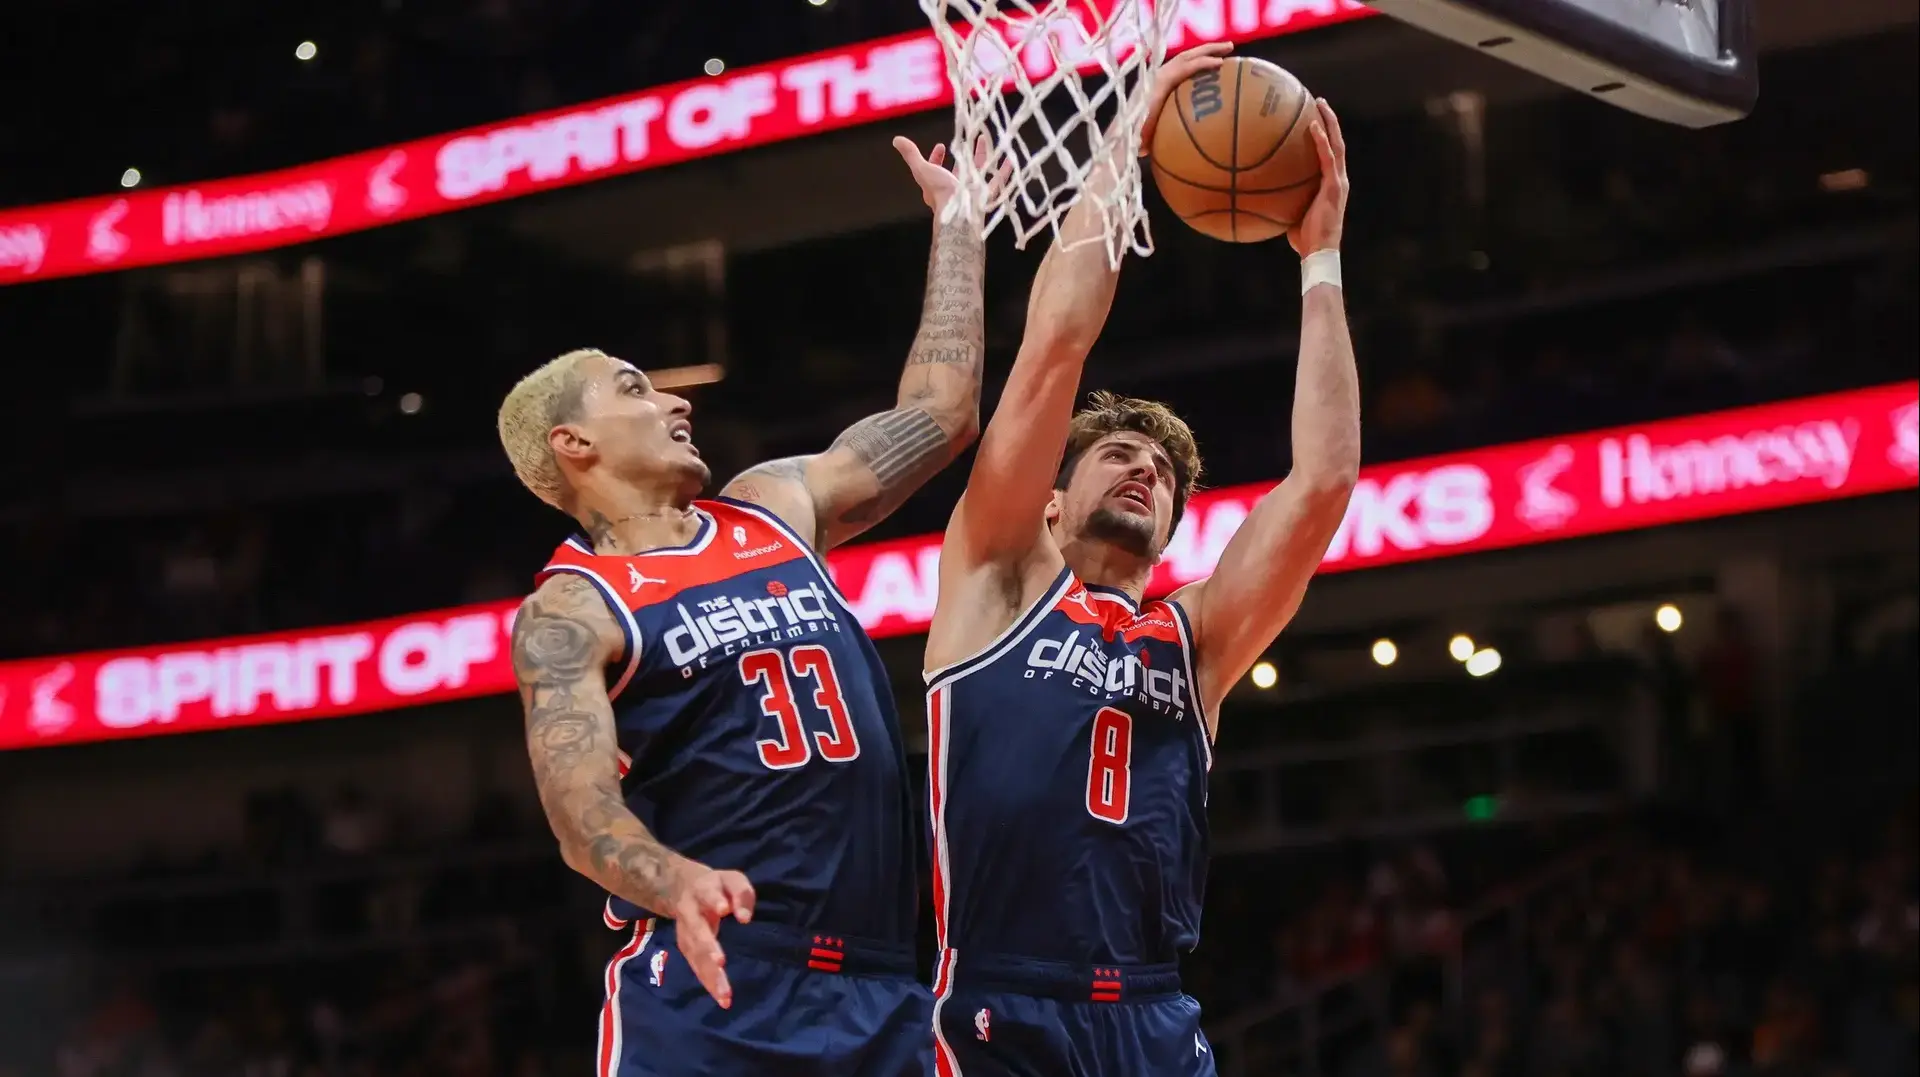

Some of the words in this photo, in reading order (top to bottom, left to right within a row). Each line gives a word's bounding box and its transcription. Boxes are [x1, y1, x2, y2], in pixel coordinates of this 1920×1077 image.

[436, 96, 664, 200] SPIRIT
[666, 71, 776, 148] OF
[781, 35, 942, 124] THE
[1599, 417, 1860, 508] Hennessy
[733, 540, 783, 560] Robinhood
[663, 580, 836, 666] district
[697, 595, 732, 613] THE
[95, 632, 374, 729] SPIRIT
[378, 613, 500, 695] OF
[681, 656, 707, 679] OF
[1024, 669, 1054, 680] OF
[1090, 637, 1109, 665] THE
[738, 644, 860, 771] 33
[1085, 705, 1133, 825] 8
